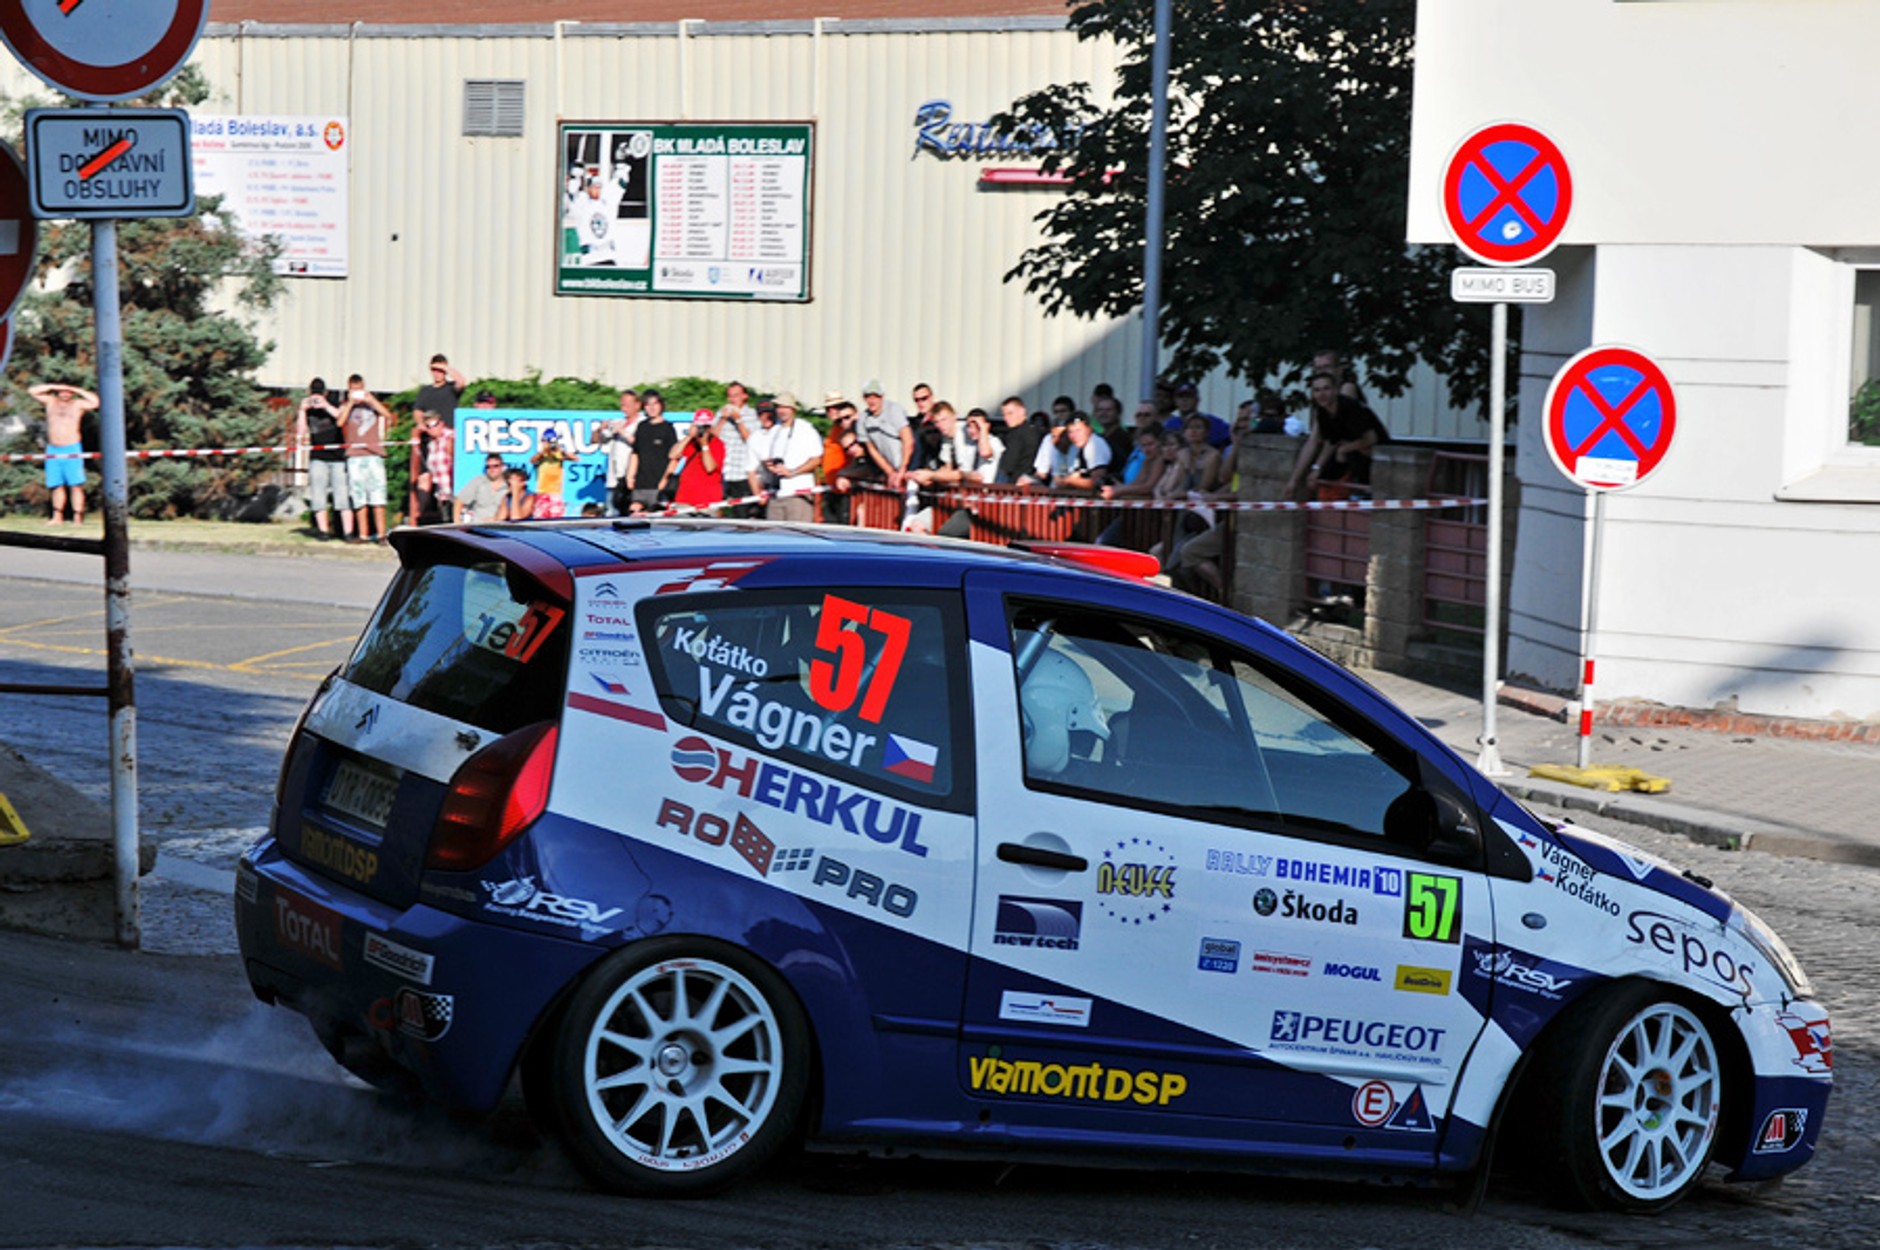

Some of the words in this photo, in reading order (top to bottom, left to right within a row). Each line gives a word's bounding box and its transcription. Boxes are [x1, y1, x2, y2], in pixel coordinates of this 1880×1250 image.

[83, 128, 138, 148] MIMO
[190, 120, 223, 136] ladá
[228, 120, 292, 138] Boleslav,
[296, 122, 319, 137] a.s.
[677, 134, 726, 154] MLADÁ
[727, 138, 805, 154] BOLESLAV
[59, 148, 165, 173] DOAVNÍ
[64, 179, 161, 199] OBSLUHY
[1462, 278, 1505, 293] MIMO
[1512, 278, 1545, 294] BUS
[505, 602, 566, 664] 57
[586, 613, 631, 627] TOTAL
[673, 626, 768, 677] Koťátko
[809, 594, 912, 725] 57
[699, 665, 877, 767] Vágner
[706, 746, 930, 859] HERKUL
[1205, 849, 1273, 876] RALLY
[1276, 858, 1371, 889] BOHEMIA
[1539, 840, 1597, 882] Vágner
[812, 855, 919, 918] PRO
[1554, 869, 1621, 917] Koťátko
[526, 891, 625, 923] RSV
[1281, 888, 1358, 925] Škoda
[1409, 872, 1459, 941] 57
[275, 895, 340, 962] TOTAL
[1204, 942, 1236, 954] global
[1626, 910, 1756, 998] sepos
[1324, 963, 1381, 981] MOGUL
[1503, 963, 1573, 991] RSV
[1302, 1016, 1447, 1052] PEUGEOT
[1363, 1088, 1385, 1115] E
